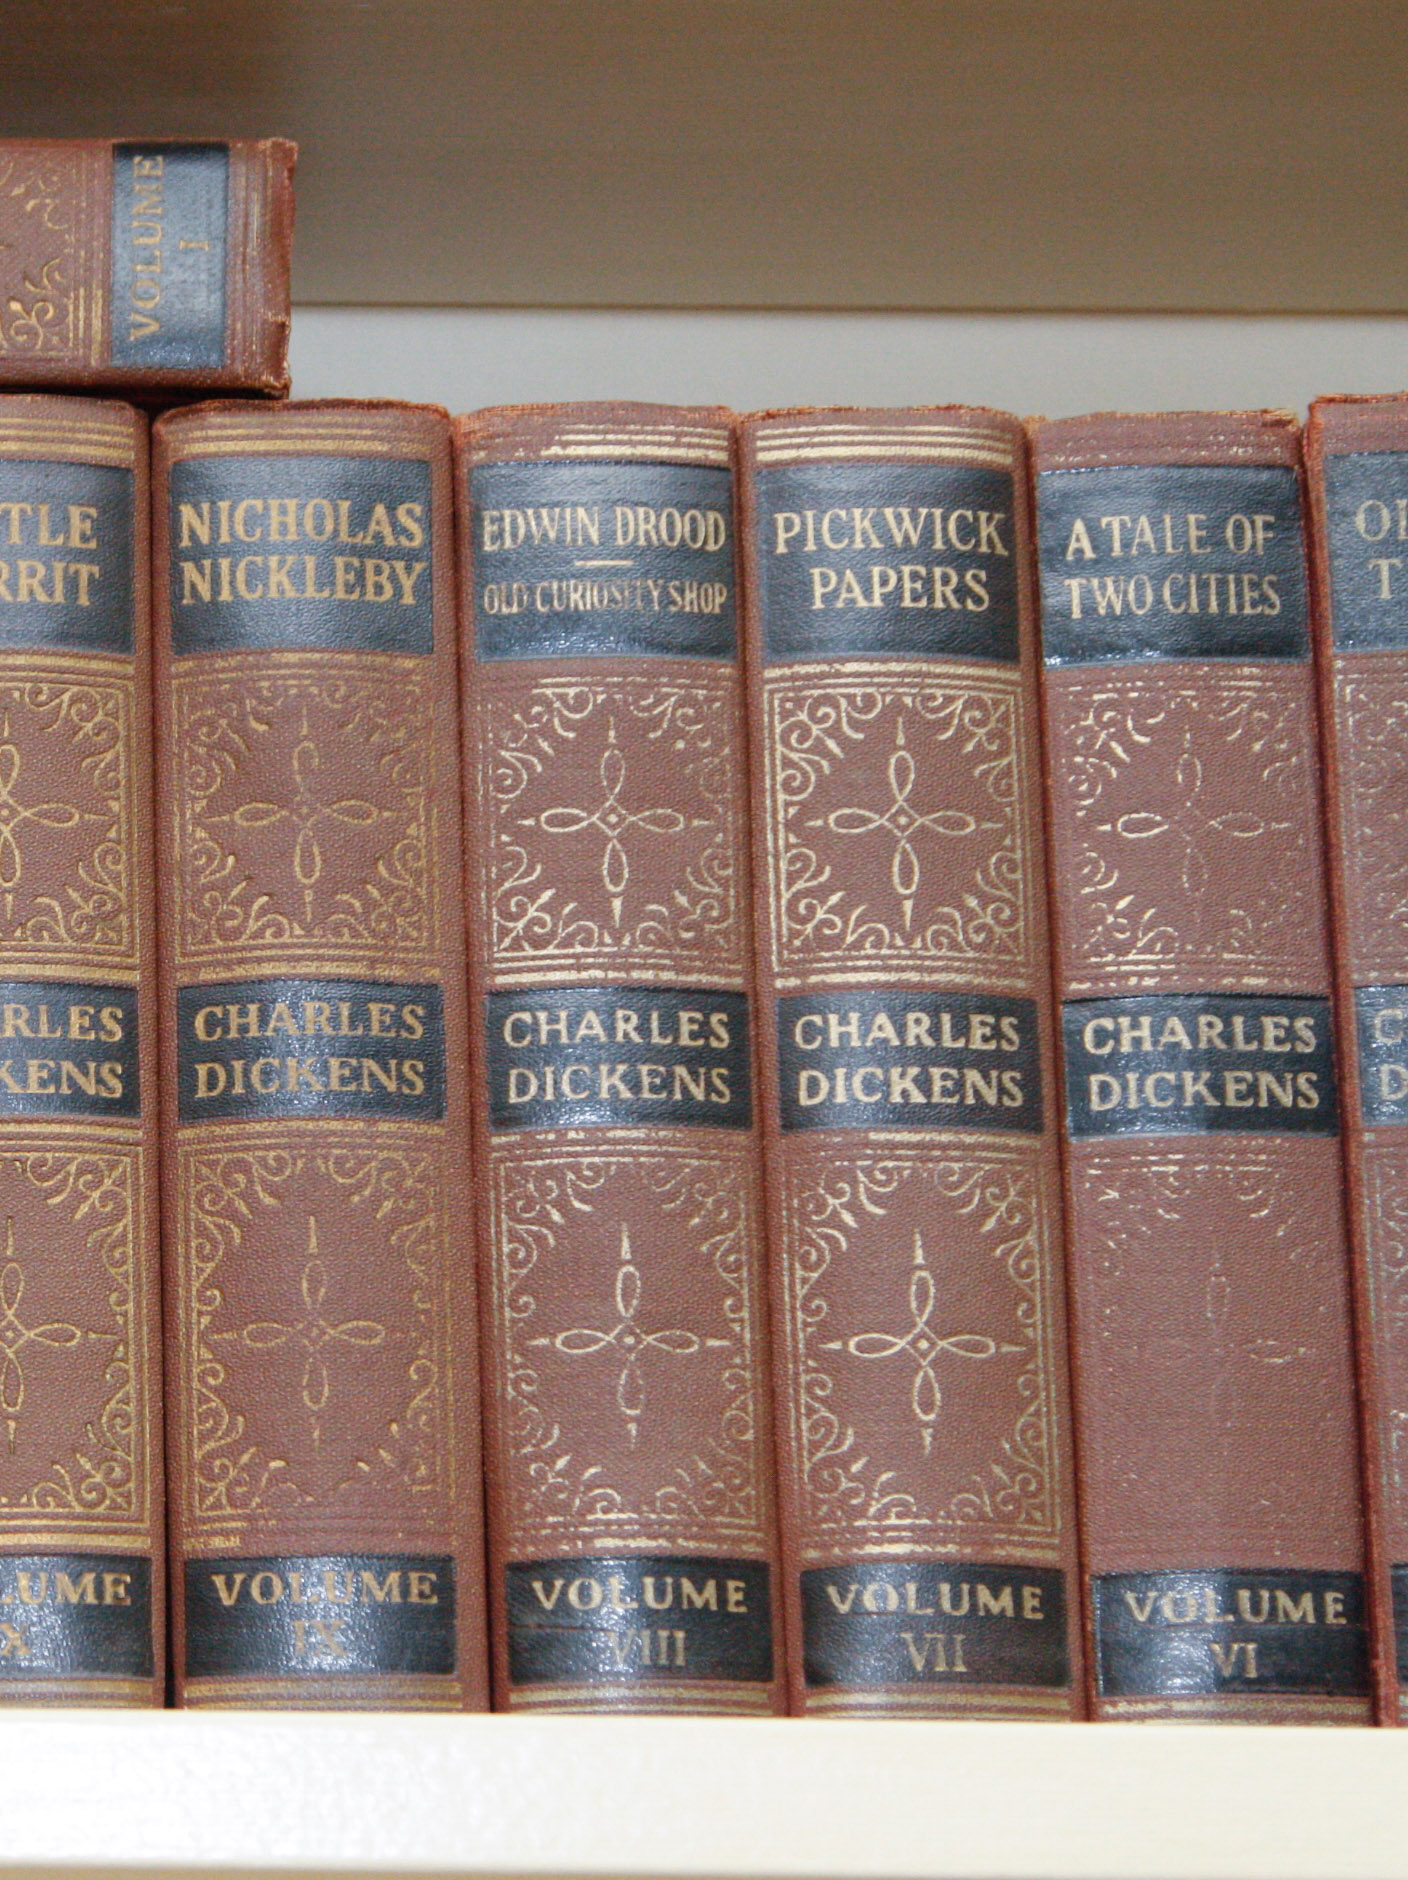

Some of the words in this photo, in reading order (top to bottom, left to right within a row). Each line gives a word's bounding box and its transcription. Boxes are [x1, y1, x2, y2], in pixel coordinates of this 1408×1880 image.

[129, 155, 163, 340] VOLUME
[179, 499, 423, 548] NICHOLAS
[482, 506, 600, 552] EDWIN
[615, 507, 726, 552] DROOD
[773, 507, 1009, 555] PICKWICK
[1065, 517, 1097, 560] A
[1100, 514, 1211, 556] TALE
[1225, 513, 1276, 556] OF
[180, 555, 429, 605] NICKLEBY
[484, 582, 529, 614] OLD
[536, 579, 664, 612] CURIOSITY
[668, 580, 728, 614] SHOP
[810, 566, 990, 612] PAPERS
[1063, 575, 1154, 619] TWO
[1163, 574, 1281, 616] CITIES
[194, 1003, 424, 1042] CHARLES
[504, 1009, 730, 1048] CHARLES
[795, 1012, 1020, 1050] CHARLES
[1083, 1015, 1316, 1055] CHARLES
[195, 1057, 424, 1098] DICKENS
[509, 1064, 730, 1103] DICKENS
[798, 1067, 1023, 1108] DICKENS
[1087, 1070, 1319, 1112] DICKENS
[211, 1572, 439, 1606] VOLUME
[532, 1576, 748, 1612] VOLUME
[826, 1584, 1044, 1620] VOLUME
[1125, 1591, 1347, 1624] VOLUME
[0, 1622, 29, 1656] X
[293, 1620, 349, 1657] IX
[606, 1628, 687, 1667] VIII
[902, 1632, 968, 1673] VII
[1210, 1642, 1258, 1679] VI
